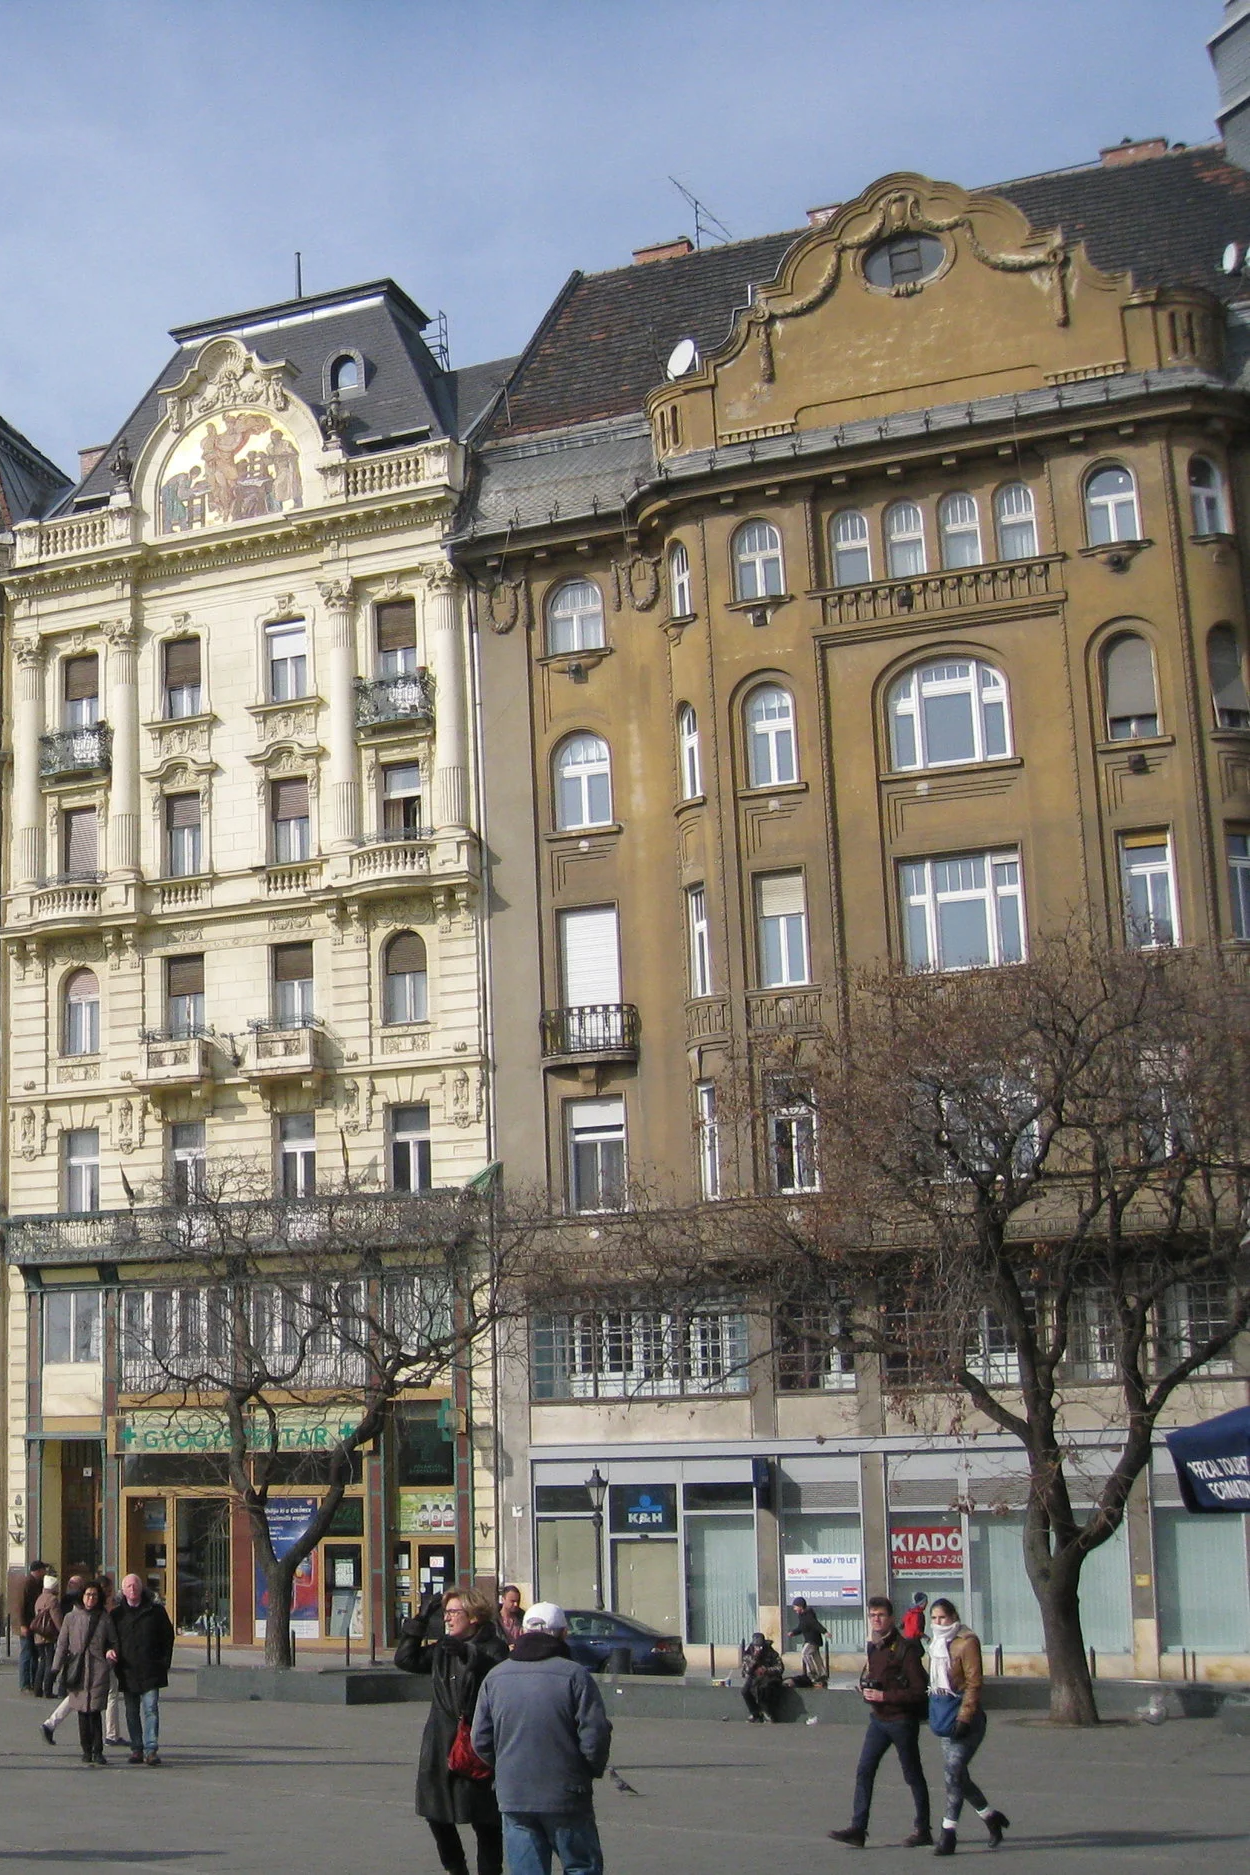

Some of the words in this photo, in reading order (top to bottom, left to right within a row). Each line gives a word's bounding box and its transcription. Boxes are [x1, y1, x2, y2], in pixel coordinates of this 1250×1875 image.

[628, 1512, 662, 1523] K&H
[891, 1528, 962, 1551] KIADÓ
[812, 1556, 832, 1564] KIADÓ
[893, 1555, 912, 1564] Tel.:
